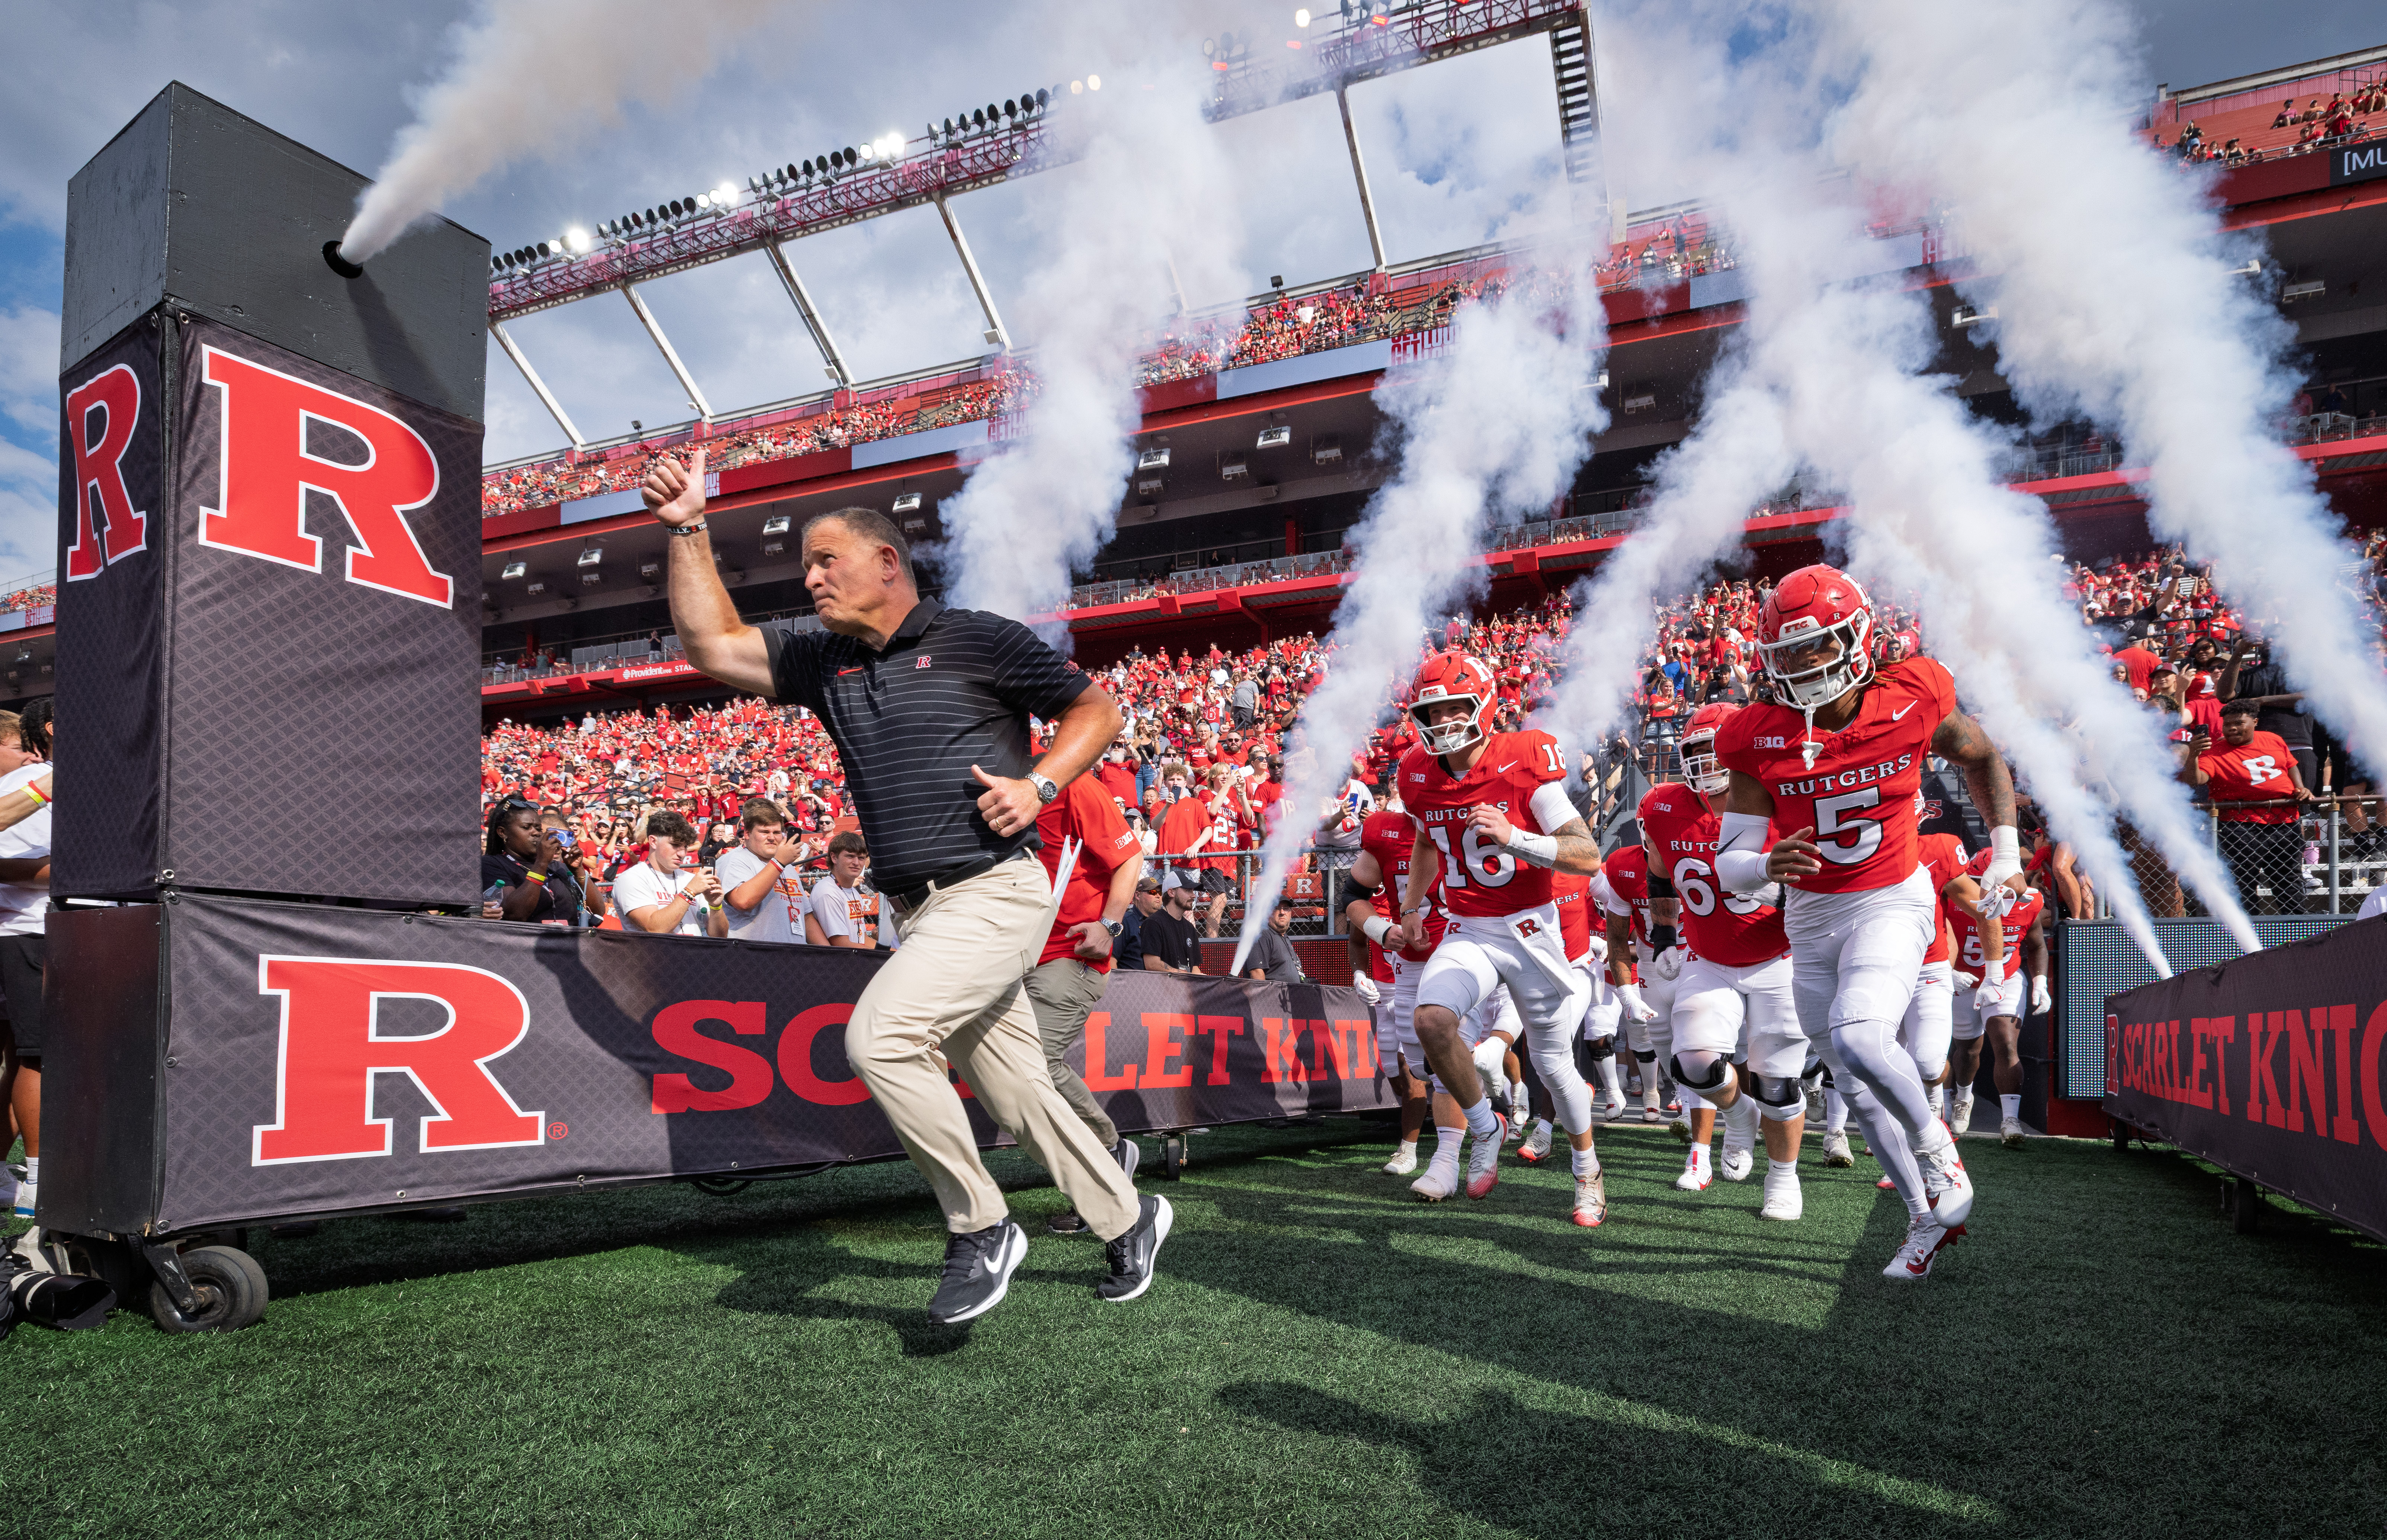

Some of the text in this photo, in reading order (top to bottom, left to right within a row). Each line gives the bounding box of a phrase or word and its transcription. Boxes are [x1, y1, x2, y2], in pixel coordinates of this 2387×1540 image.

[67, 363, 147, 582] R
[198, 343, 453, 610] R
[1899, 636, 1911, 645] R
[915, 656, 931, 669] R
[1463, 657, 1495, 683] R
[631, 666, 663, 678] Provident
[818, 763, 828, 771] R
[1778, 753, 1912, 796] RUTGERS
[2242, 754, 2282, 786] R
[824, 802, 833, 812] R
[1425, 801, 1509, 822] RUTGS
[1812, 785, 1883, 866] 5
[1671, 840, 1720, 853] RUTG
[683, 856, 692, 864] R
[1428, 824, 1517, 889] 16
[1296, 878, 1313, 893] R
[1448, 922, 1462, 935] R
[1516, 918, 1541, 939] R
[1686, 951, 1698, 963] R
[1395, 963, 1402, 975] R
[251, 954, 546, 1167] R
[2107, 1014, 2119, 1096] R
[2123, 1016, 2235, 1116] SCARLET
